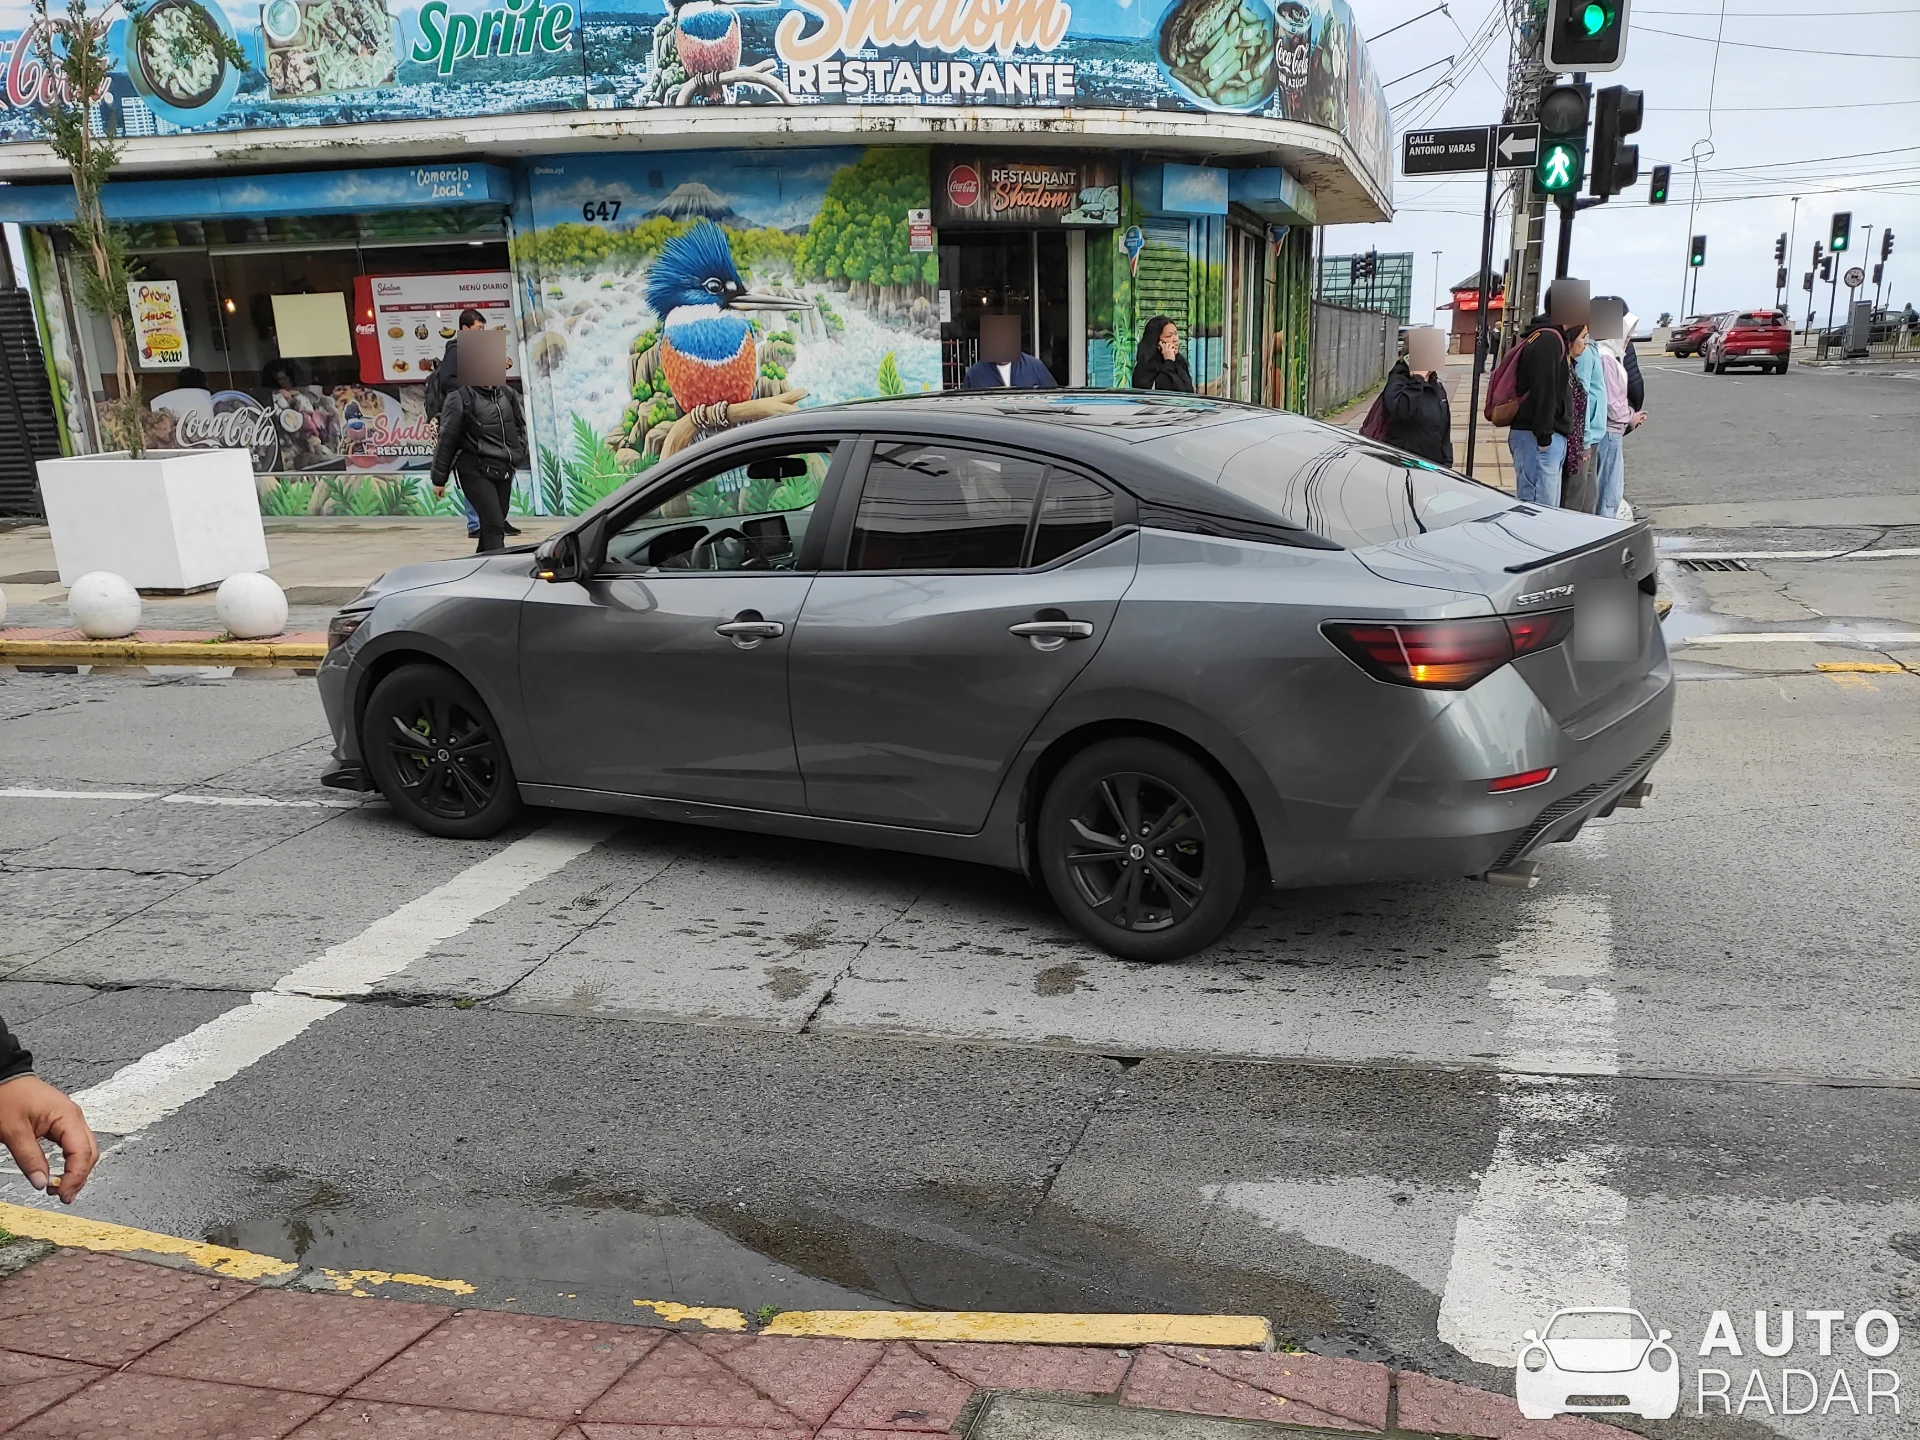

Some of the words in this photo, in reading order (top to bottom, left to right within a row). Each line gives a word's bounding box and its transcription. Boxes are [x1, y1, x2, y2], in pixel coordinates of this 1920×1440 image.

[411, 0, 575, 76] Sprite
[775, 0, 1071, 63] Shalom
[788, 61, 1076, 96] RESTAURANTE
[1409, 134, 1435, 145] CALLE
[1409, 145, 1445, 156] ANTONIO
[1448, 143, 1476, 153] VARAS
[949, 180, 978, 194] Coca-Cola
[991, 169, 1077, 186] RESTAURANT
[992, 180, 1071, 212] Shalom
[582, 200, 622, 221] 647
[459, 282, 481, 292] MENÚ
[483, 282, 509, 291] DIARIO
[175, 404, 282, 448] Coca-Cola
[373, 412, 432, 446] Shalo
[376, 445, 434, 456] RESTAURA
